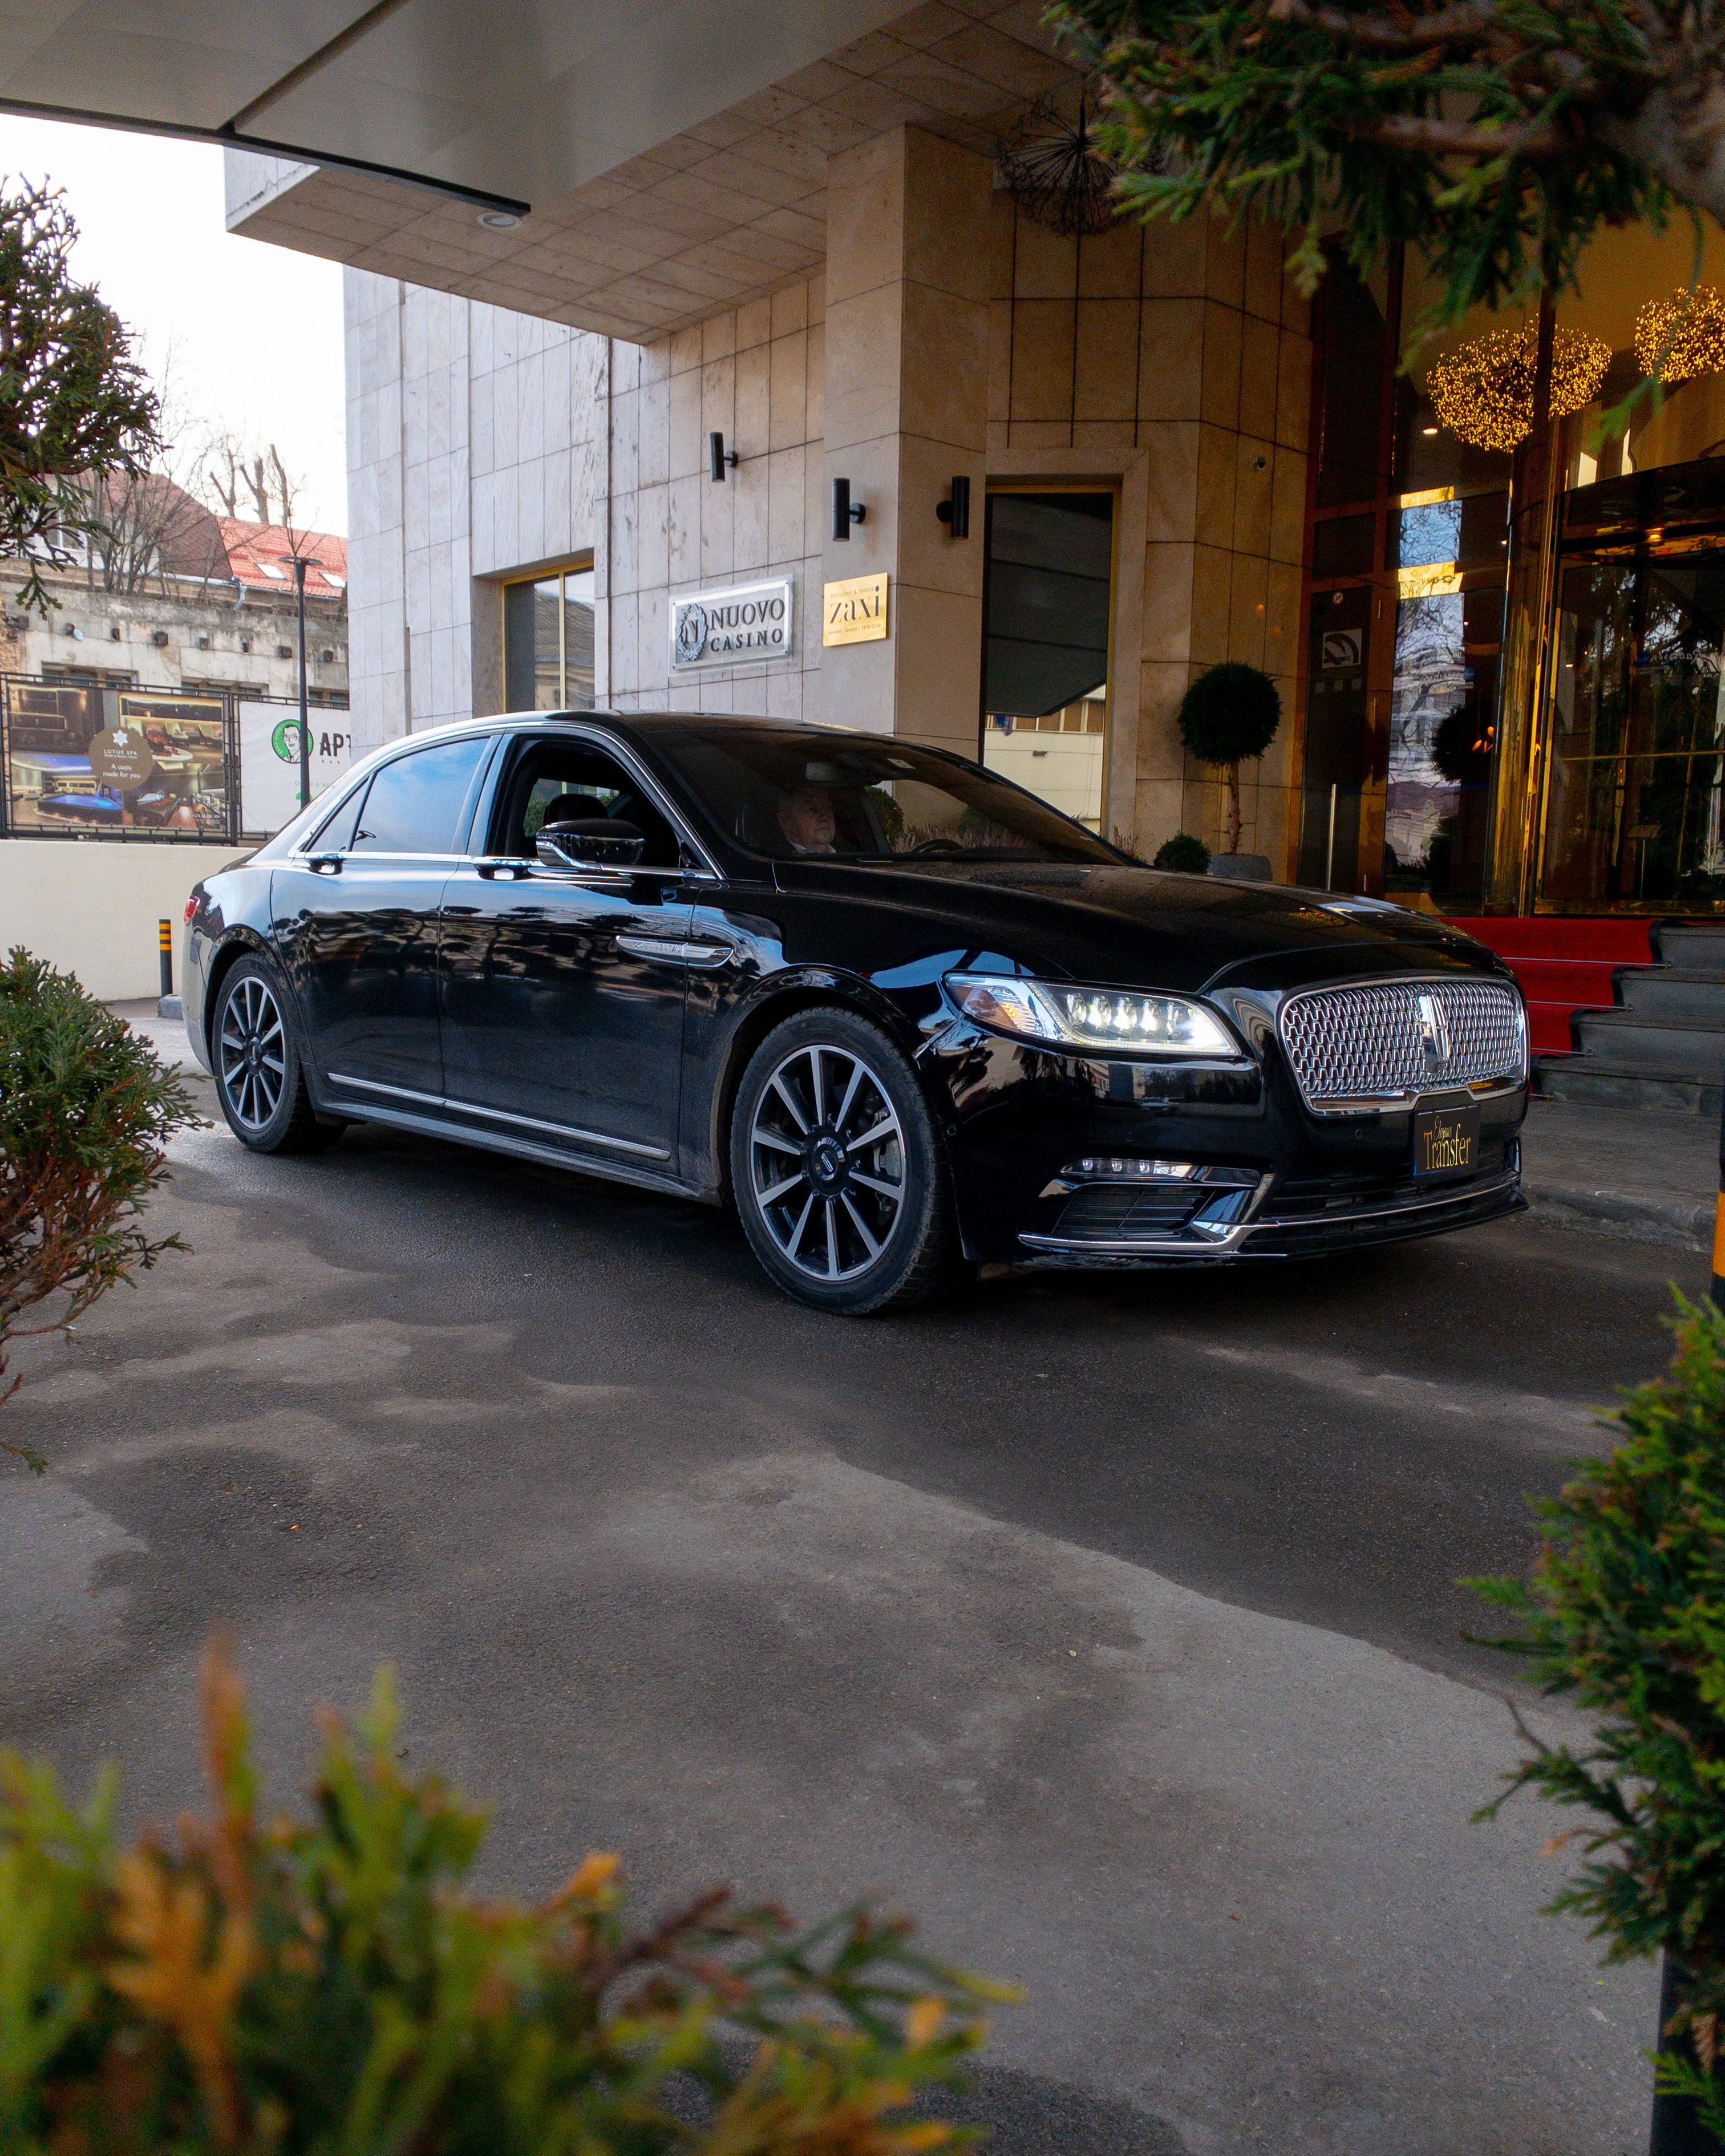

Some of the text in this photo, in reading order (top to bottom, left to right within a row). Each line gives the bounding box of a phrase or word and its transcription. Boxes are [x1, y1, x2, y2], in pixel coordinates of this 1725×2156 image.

[709, 598, 785, 631] NUOVO
[830, 585, 880, 624] zaxi
[710, 628, 783, 652] CASINO
[633, 941, 681, 953] CONTNENTAL
[1424, 1123, 1471, 1169] Transfer
[1434, 1116, 1452, 1145] Elegance
